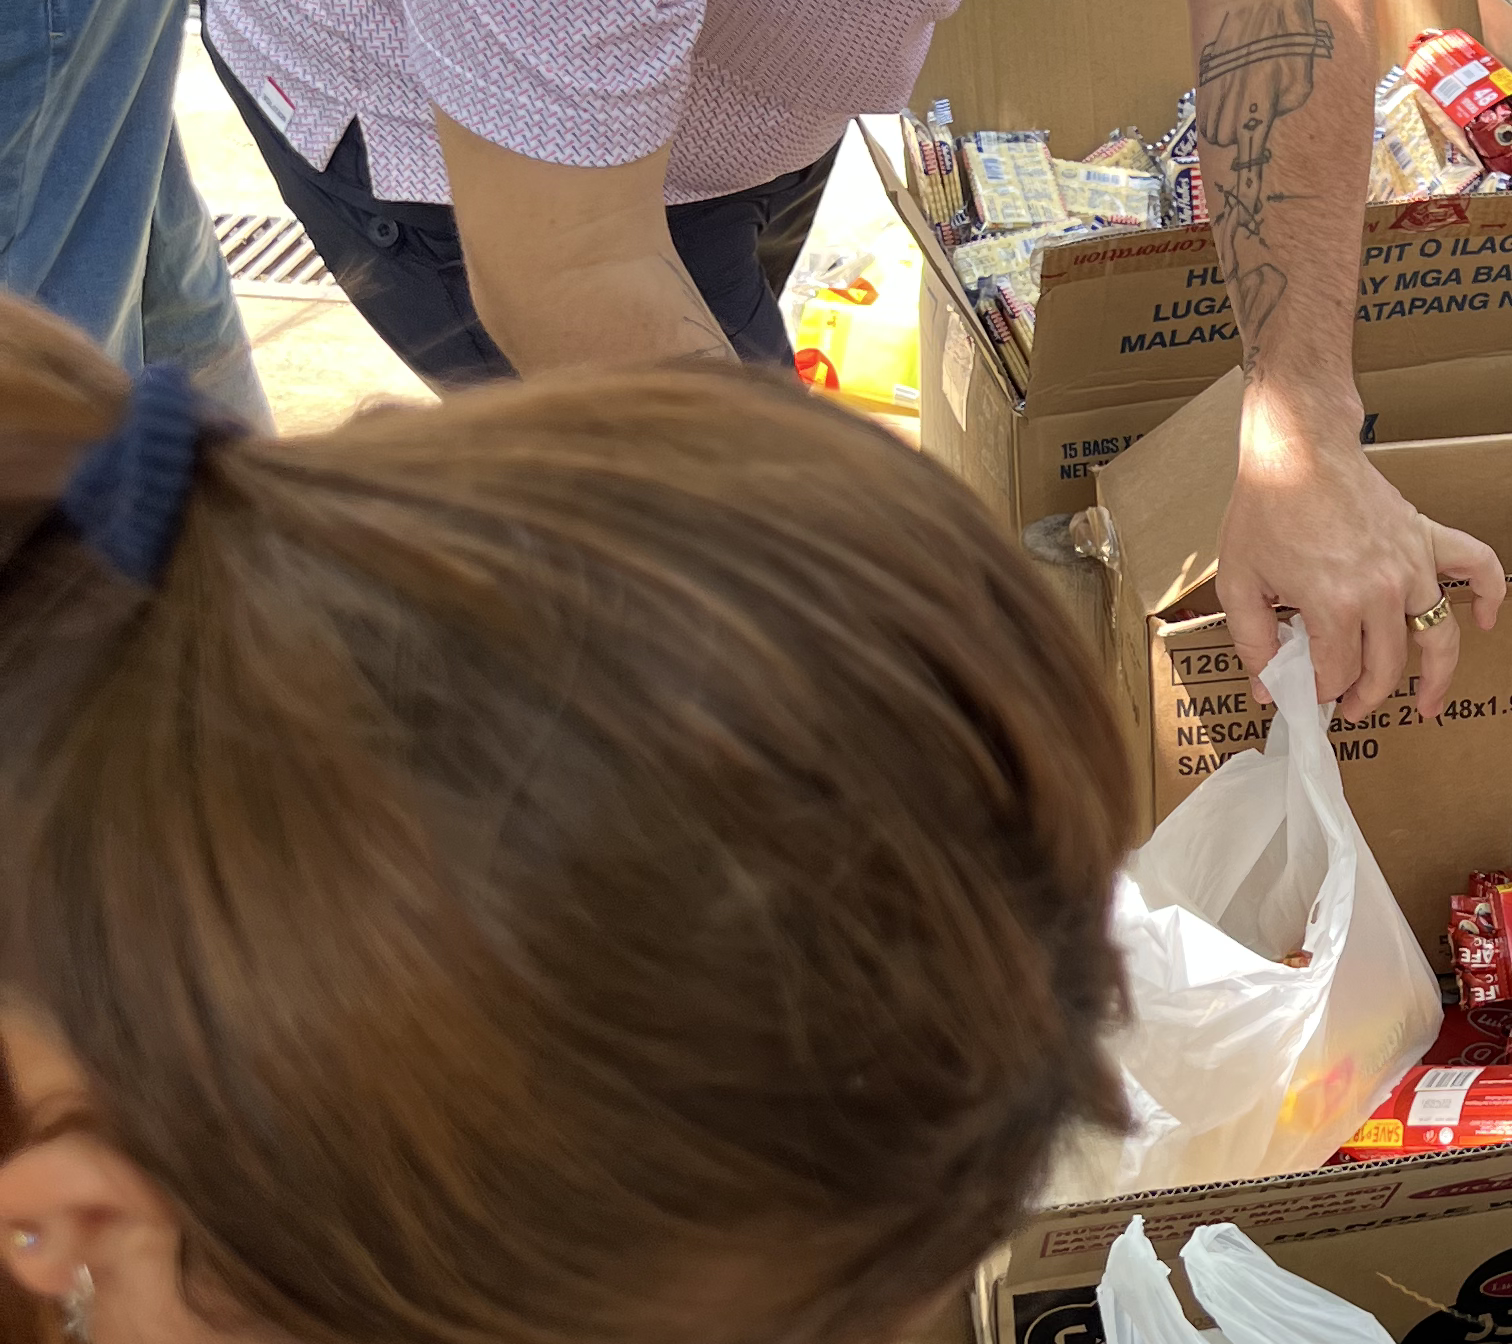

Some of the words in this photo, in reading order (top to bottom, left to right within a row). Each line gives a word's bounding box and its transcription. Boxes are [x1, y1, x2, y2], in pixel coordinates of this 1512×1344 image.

[1418, 238, 1443, 258] O
[1394, 266, 1463, 293] MGA
[1152, 295, 1233, 323] LUGA
[1119, 321, 1243, 354] MALAKA
[1355, 293, 1489, 324] ATAPANG
[1061, 442, 1079, 459] 15
[1082, 436, 1120, 457] BAGS
[1060, 461, 1090, 480] NET
[1176, 692, 1248, 718] MAKE
[1177, 719, 1272, 746] NESCAF
[1330, 711, 1391, 733] assic
[1178, 752, 1232, 776] SAV
